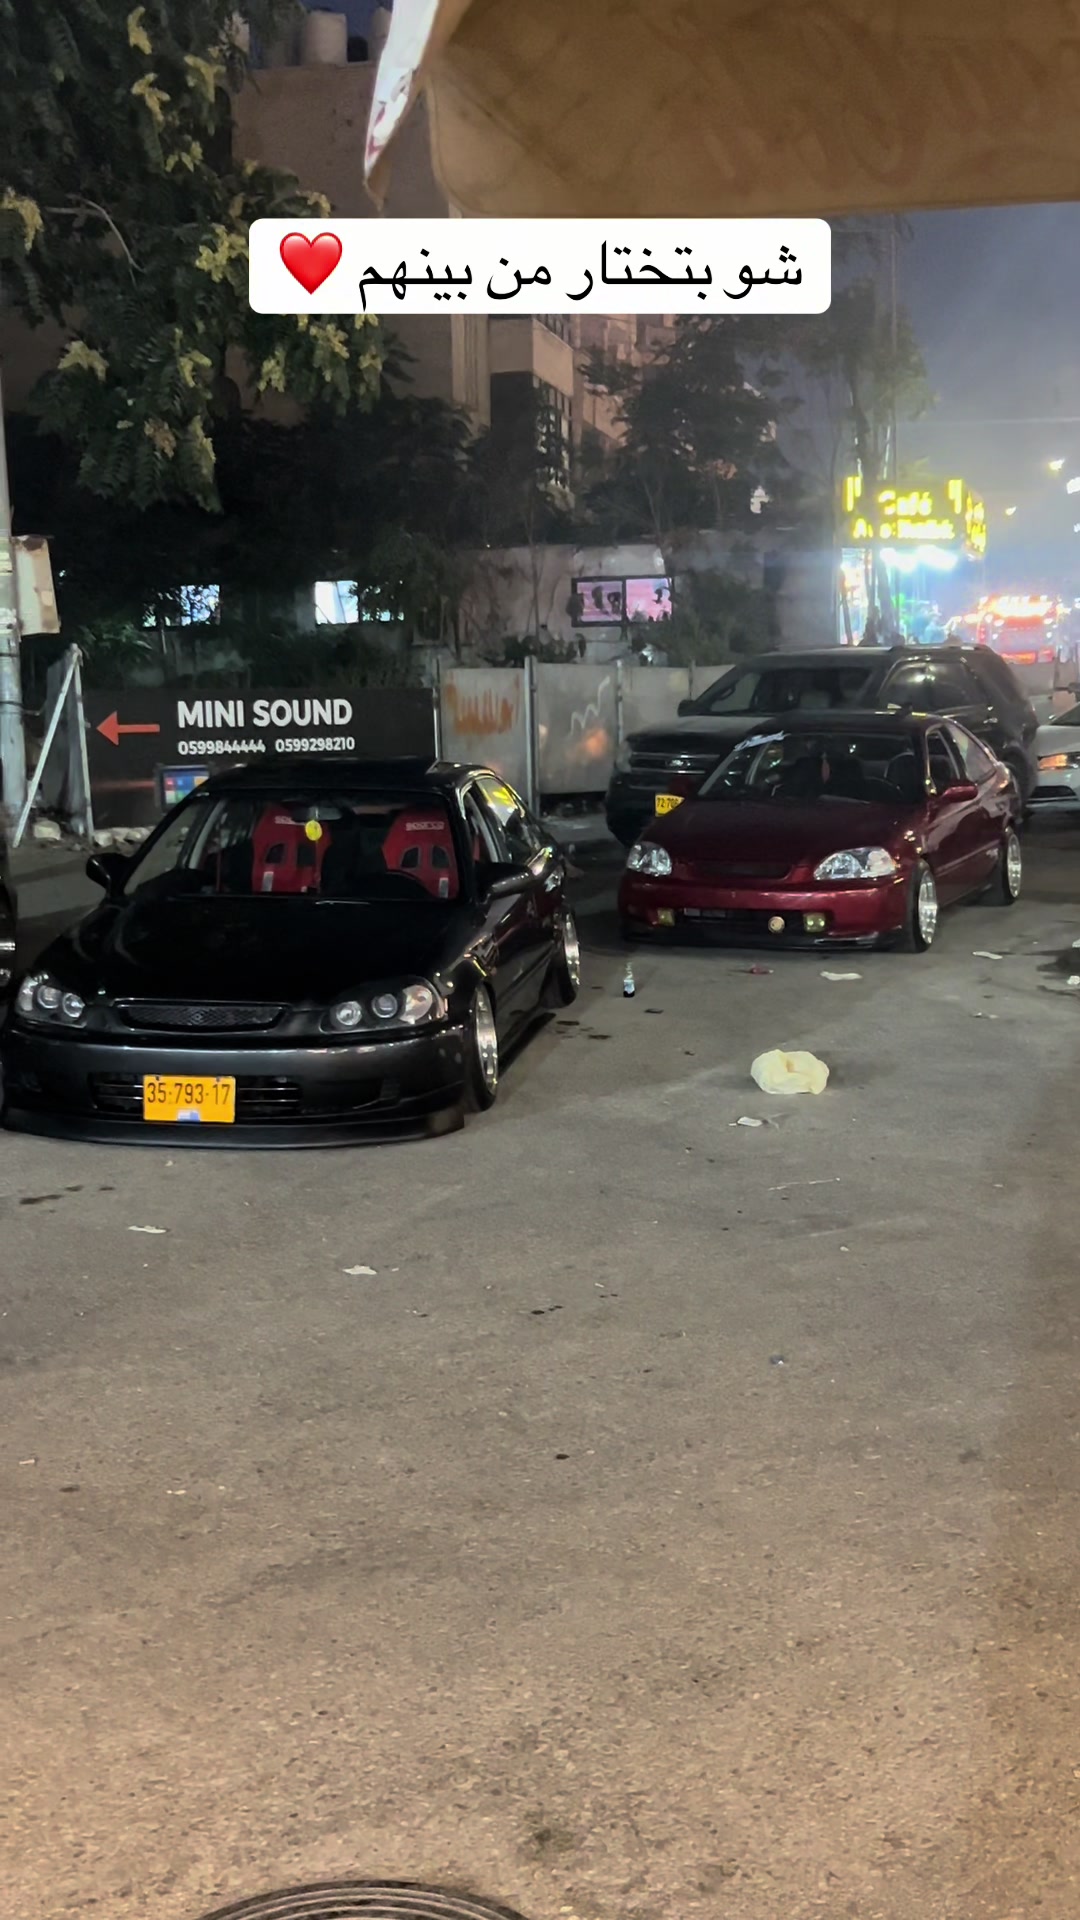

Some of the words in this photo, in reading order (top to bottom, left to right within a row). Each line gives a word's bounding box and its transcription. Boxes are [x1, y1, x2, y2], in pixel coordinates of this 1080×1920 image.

[177, 700, 245, 728] MINI
[252, 698, 353, 727] SOUND
[177, 739, 266, 755] 0599844444
[275, 736, 355, 752] 0599298210
